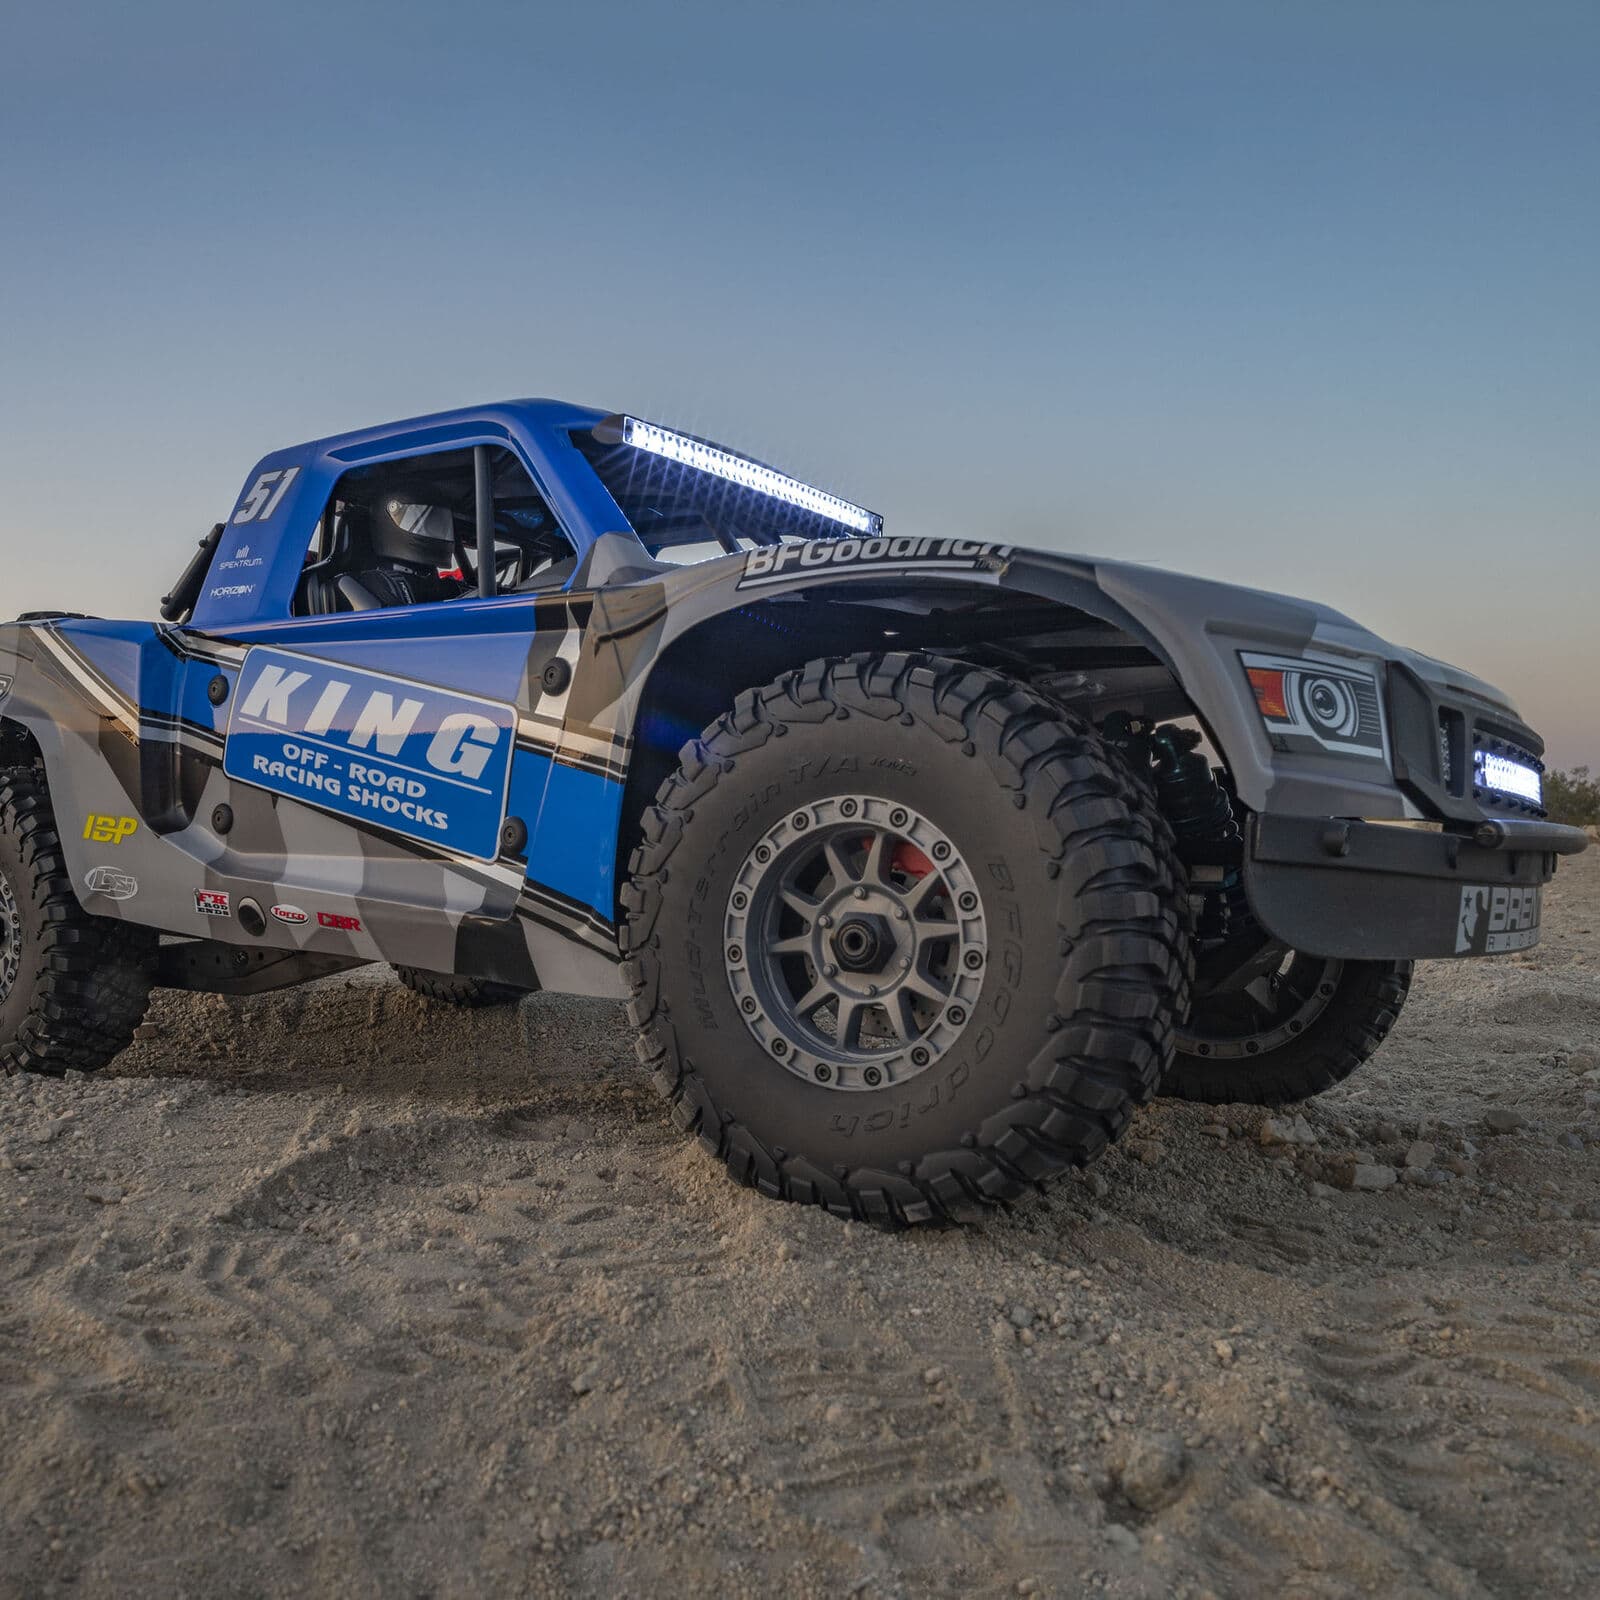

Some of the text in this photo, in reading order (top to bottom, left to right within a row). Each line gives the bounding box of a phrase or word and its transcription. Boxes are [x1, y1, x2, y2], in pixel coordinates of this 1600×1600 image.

[232, 466, 301, 524] 51
[219, 558, 263, 570] SPEKTRUM
[210, 584, 254, 597] HORIZON
[239, 664, 501, 780] KING
[282, 743, 329, 770] OFF
[348, 762, 427, 799] ROAD
[253, 754, 449, 830] RACING SHOCKS
[197, 907, 229, 916] ENDS
[204, 902, 228, 911] ROD
[273, 907, 305, 921] Torco
[831, 863, 1023, 1137] BFGoodrich
